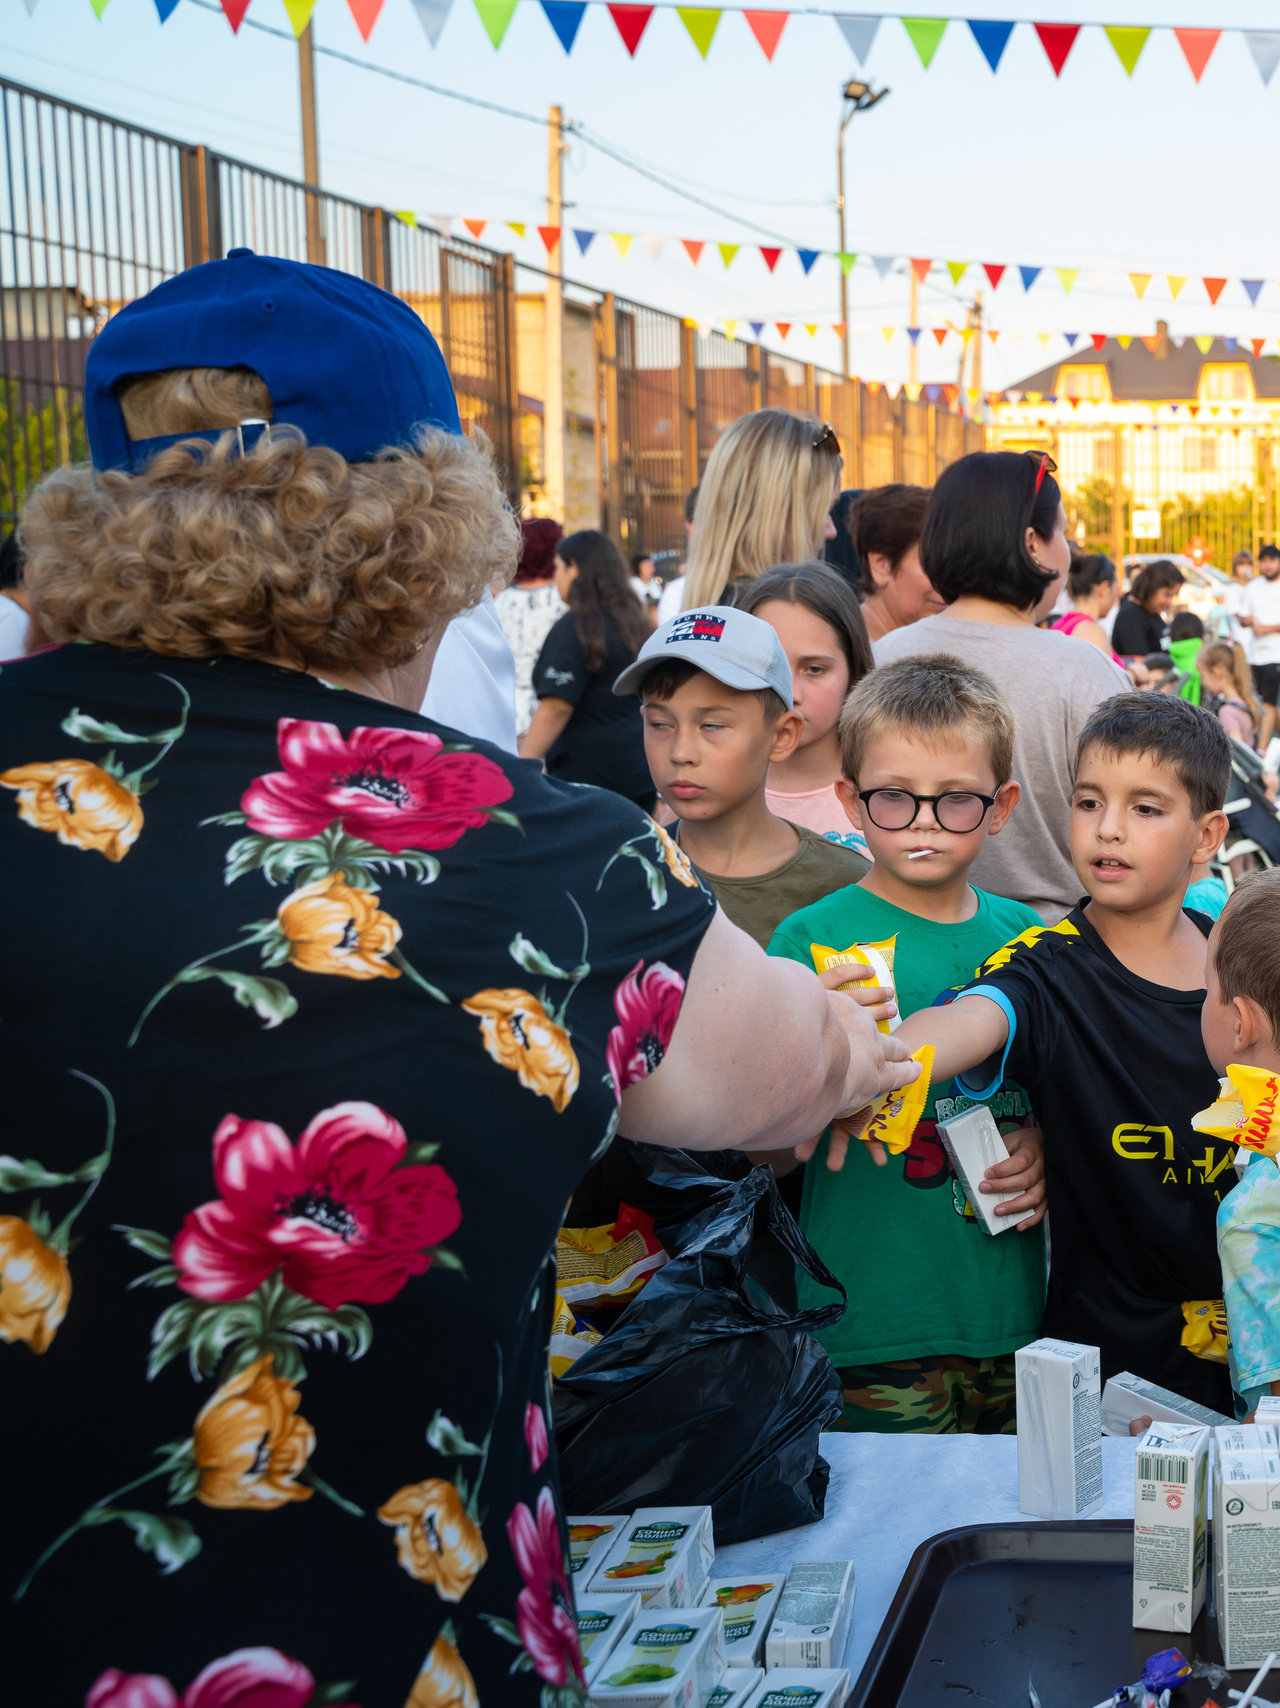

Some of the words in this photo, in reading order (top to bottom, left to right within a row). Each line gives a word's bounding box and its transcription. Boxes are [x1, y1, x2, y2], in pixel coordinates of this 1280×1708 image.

[677, 614, 722, 623] TOMMY
[668, 634, 716, 642] JEANS
[935, 1091, 1026, 1123] BRWL
